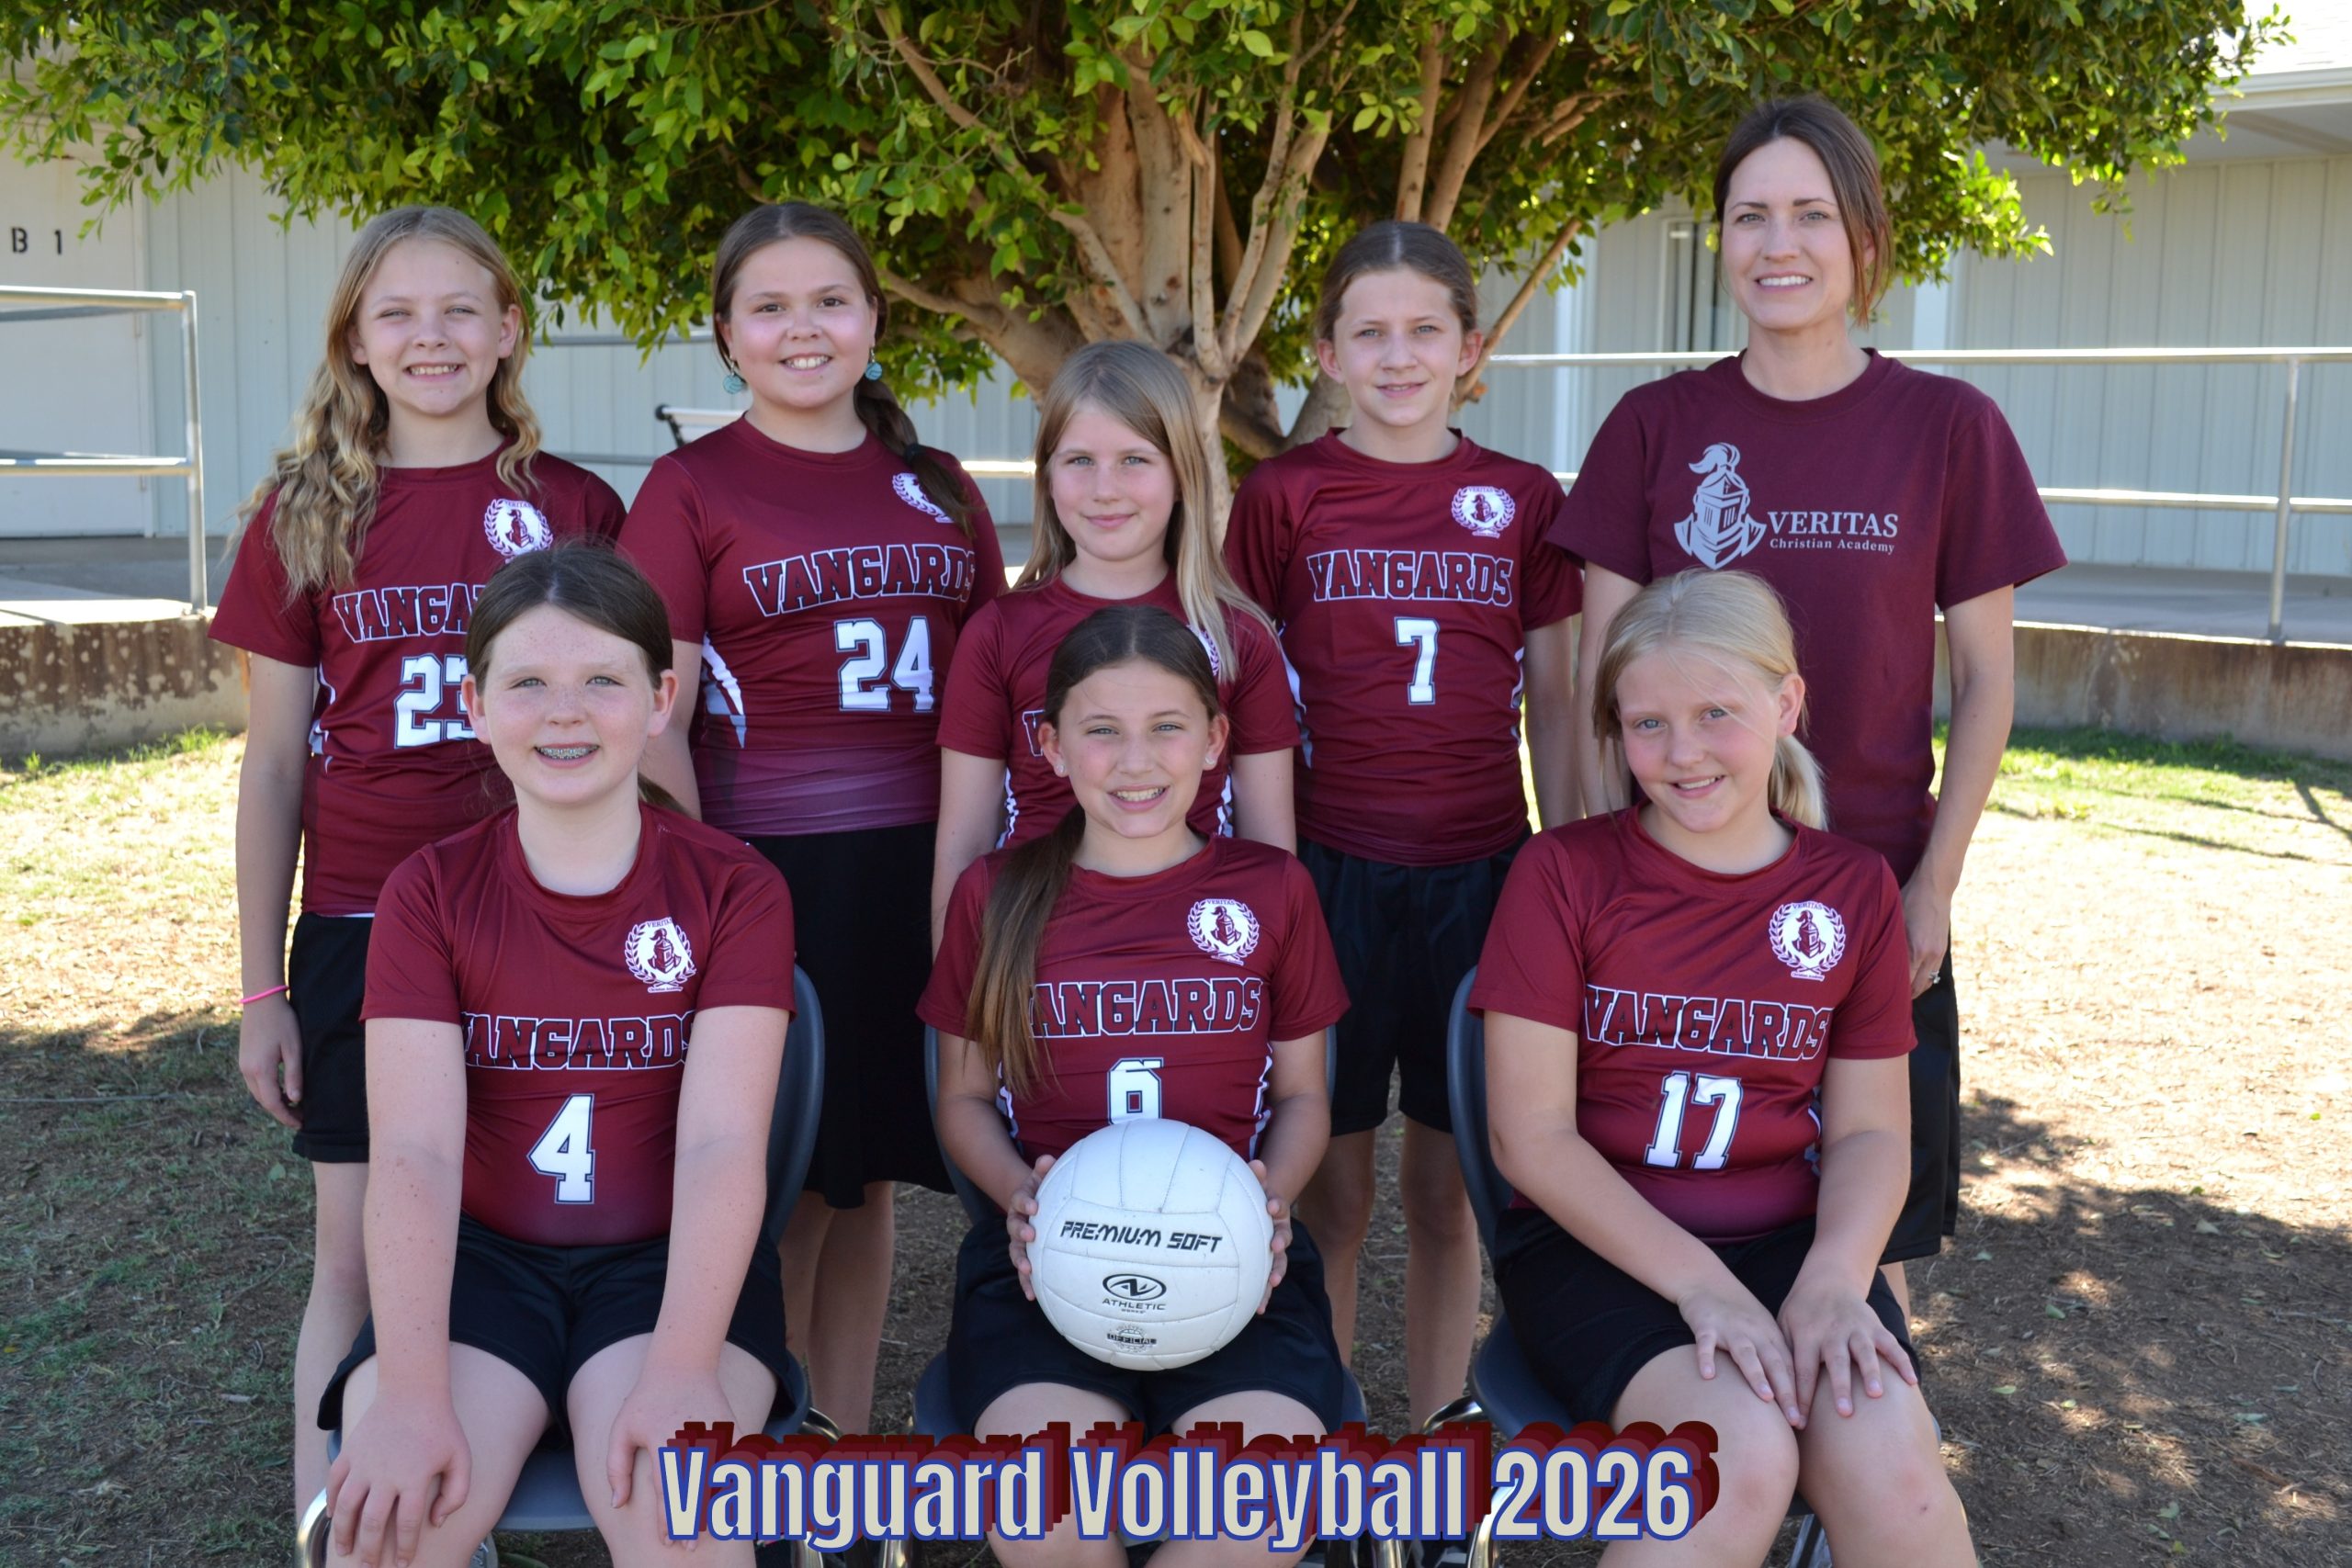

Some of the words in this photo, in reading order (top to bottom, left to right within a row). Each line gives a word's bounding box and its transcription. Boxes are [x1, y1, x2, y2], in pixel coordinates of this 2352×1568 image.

[11, 227, 28, 254] B
[53, 229, 62, 254] 1
[1767, 511, 1899, 538] VERITAS
[1770, 537, 1833, 549] Christian
[1837, 538, 1895, 555] Academy
[743, 544, 976, 617] VANGARDS
[1306, 549, 1515, 607] VANGARDS
[334, 583, 487, 643] VANGA
[834, 615, 934, 713] 24
[1394, 616, 1441, 705] 7
[1029, 976, 1263, 1038] ANGARDS
[1585, 984, 1835, 1061] VANGARDS
[1107, 1057, 1164, 1124] 6
[1644, 1070, 1744, 1170] 17
[526, 1093, 596, 1204] 4
[1060, 1221, 1162, 1247] PREMIUM
[1167, 1232, 1223, 1253] SOFT
[1102, 1298, 1167, 1311] ATHLETIC
